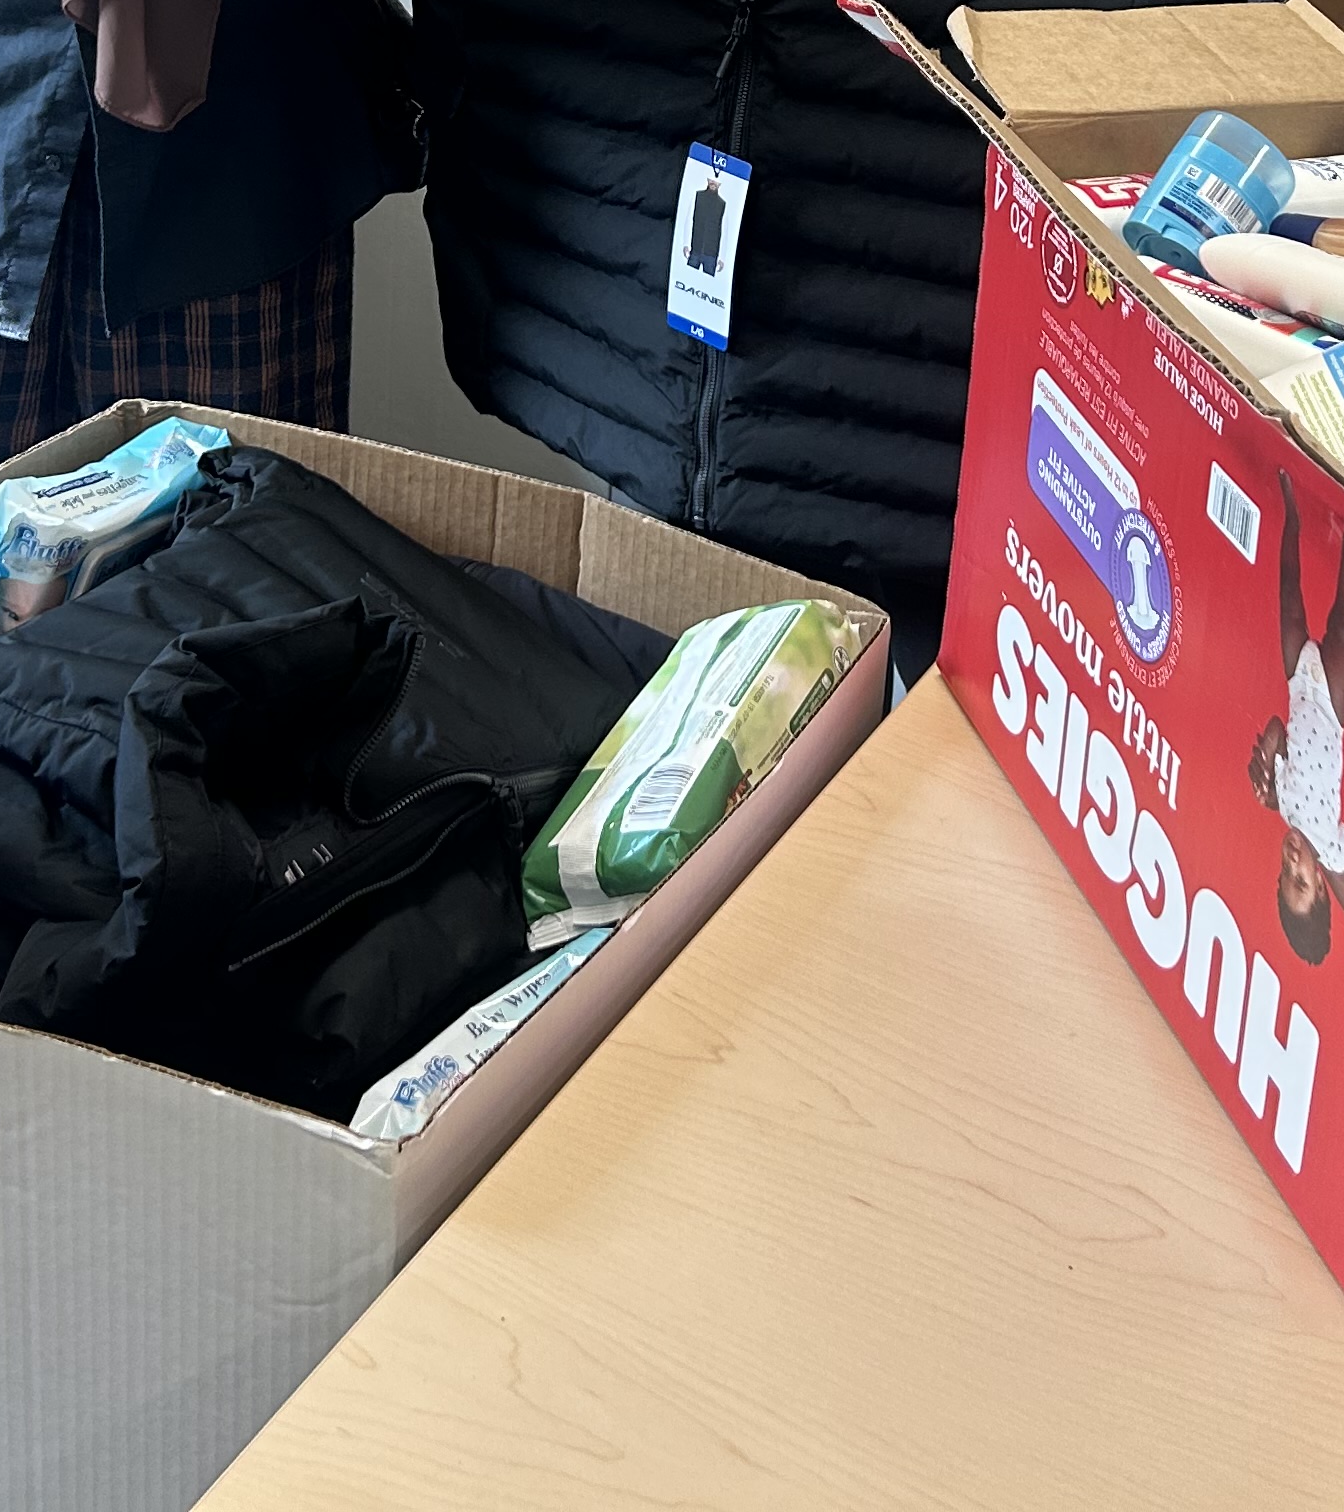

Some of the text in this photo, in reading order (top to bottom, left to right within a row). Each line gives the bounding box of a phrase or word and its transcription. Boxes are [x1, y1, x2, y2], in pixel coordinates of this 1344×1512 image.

[713, 154, 727, 168] L/G
[994, 162, 1008, 211] 4
[1009, 201, 1034, 250] 120
[674, 280, 726, 309] DAKINE
[690, 324, 705, 338] L/G
[1145, 312, 1239, 420] GRANDE VALEUR
[1154, 346, 1224, 436] HUGE VALUE
[1039, 330, 1147, 467] ACTIVE FIT EST REMARQUABLE
[1038, 458, 1102, 551] OUTSTANDING
[1047, 446, 1097, 517] ACTIVE FIT
[1114, 524, 1125, 550] FIT
[1123, 512, 1156, 546] STRETCHY
[1147, 496, 1176, 559] HUGGIES
[1117, 599, 1142, 653] CURVED
[1147, 609, 1171, 658] HUGGIES
[1174, 585, 1184, 641] COUPE
[1004, 524, 1182, 811] little movers
[1110, 617, 1148, 686] EXTENSIBLE
[992, 603, 1321, 1176] HUGGIES
[465, 968, 554, 1041] Baby Wipes
[391, 1053, 462, 1112] Fluffs
